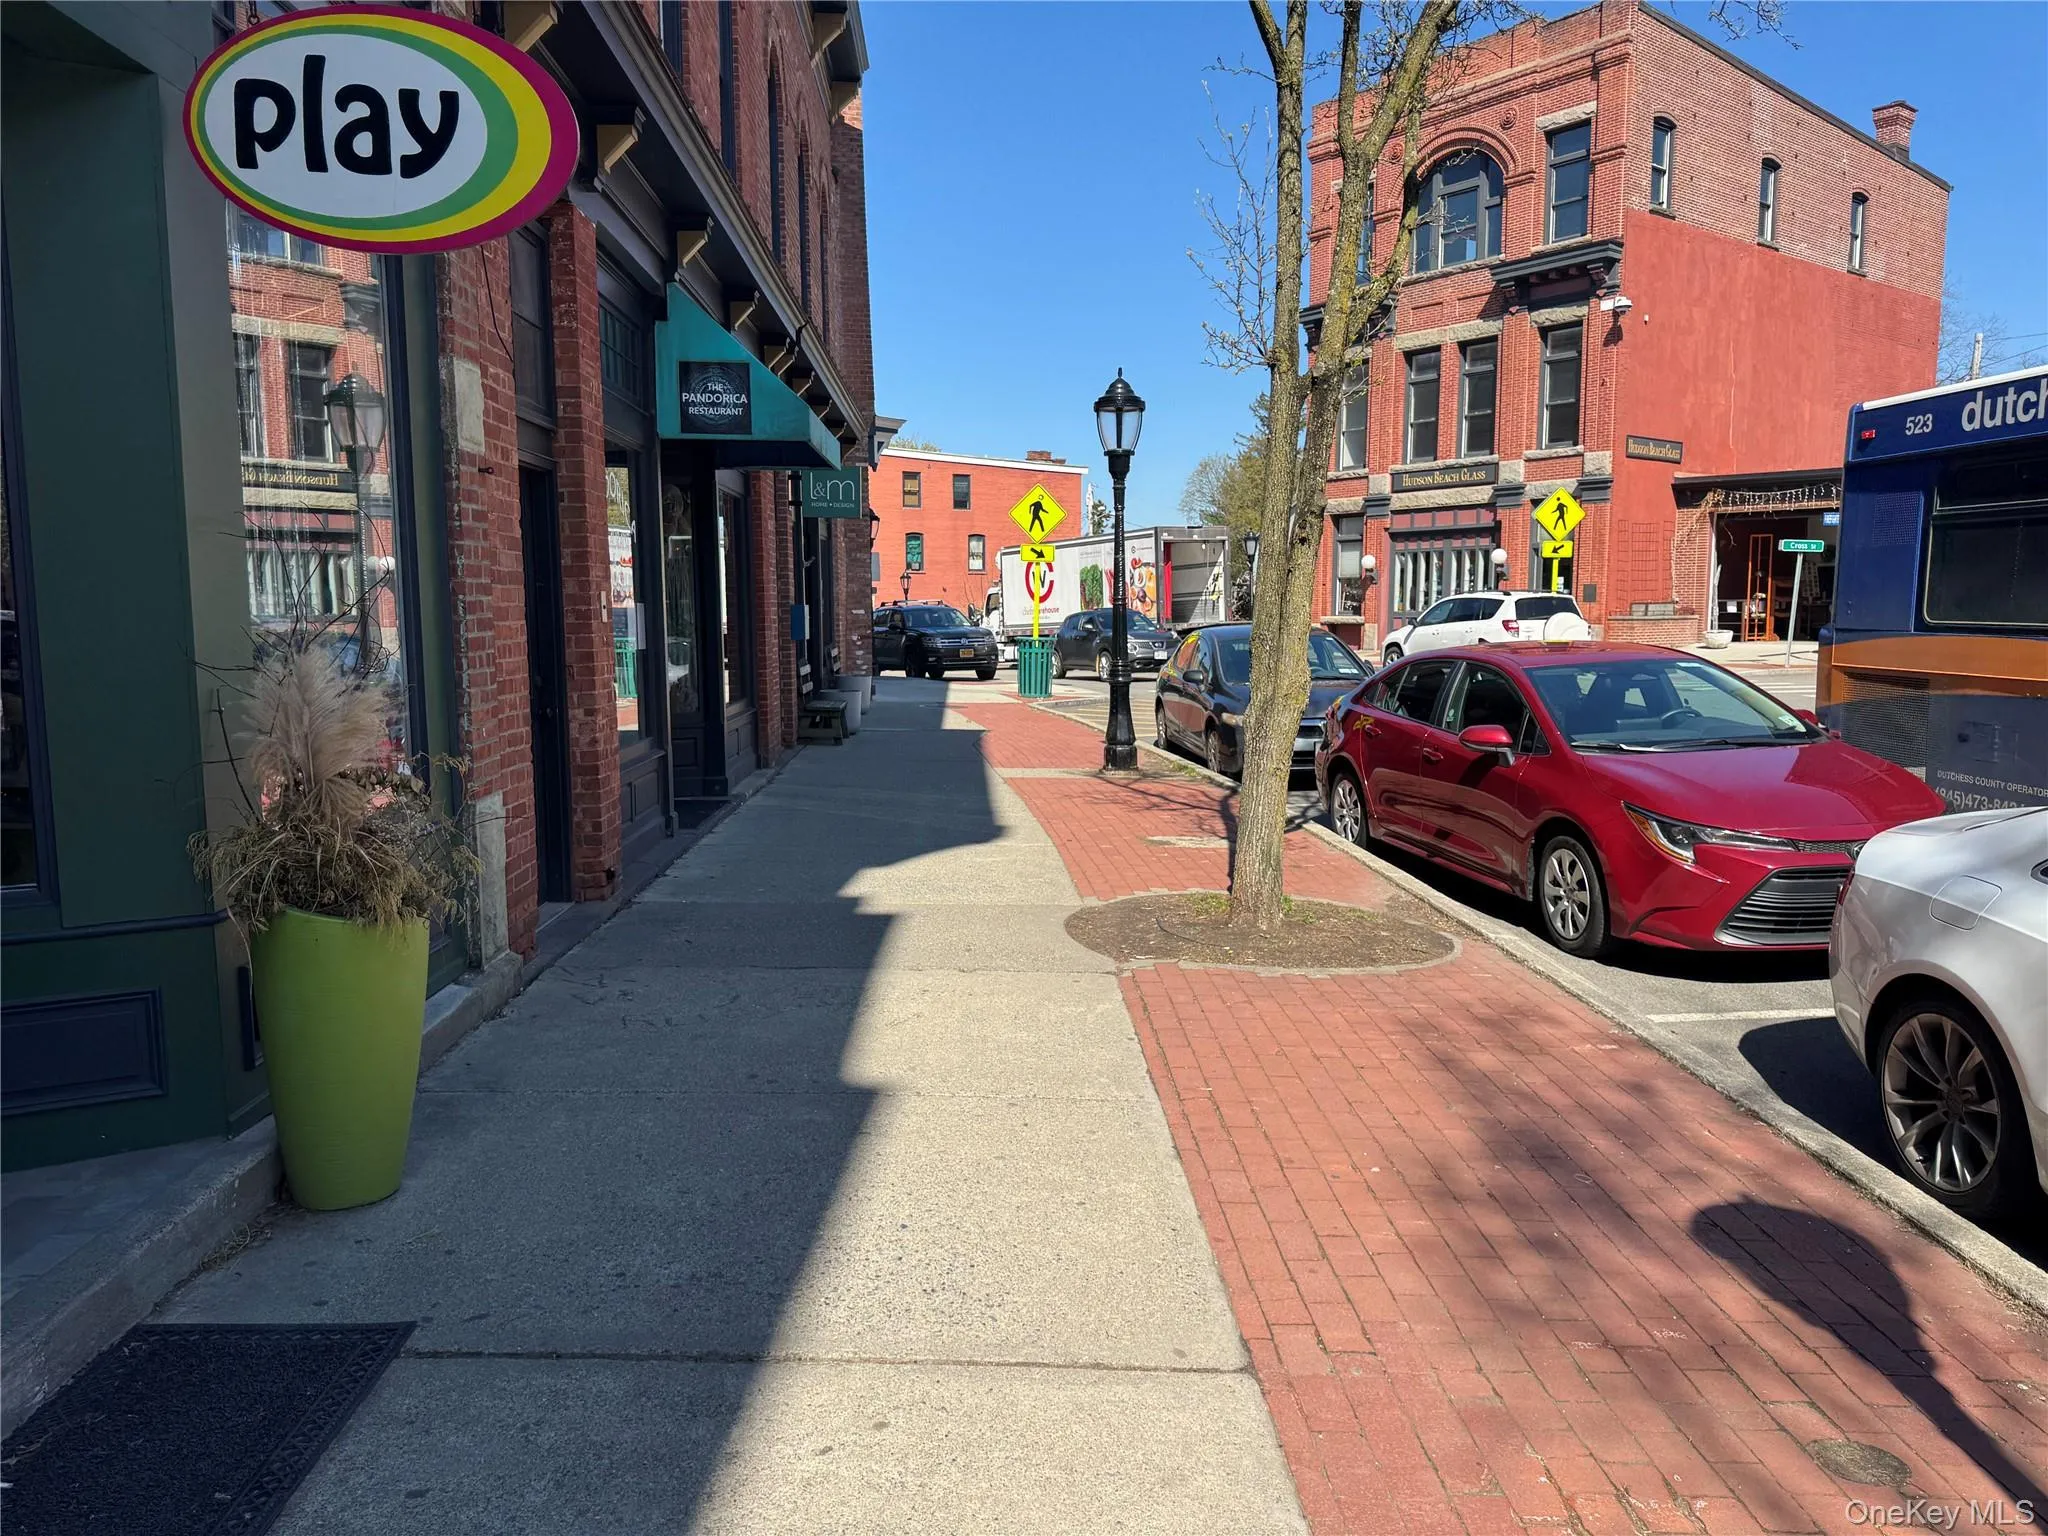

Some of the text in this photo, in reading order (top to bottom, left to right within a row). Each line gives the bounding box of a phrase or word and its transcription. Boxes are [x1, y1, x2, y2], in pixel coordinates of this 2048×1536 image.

[234, 54, 459, 179] play
[707, 383, 723, 391] THE
[682, 393, 748, 403] PANDORICA
[688, 407, 743, 415] RESTAURANT
[1905, 413, 1933, 435] 523
[1937, 770, 1974, 784] DUTCHESS
[1975, 776, 2005, 789] COUNTY
